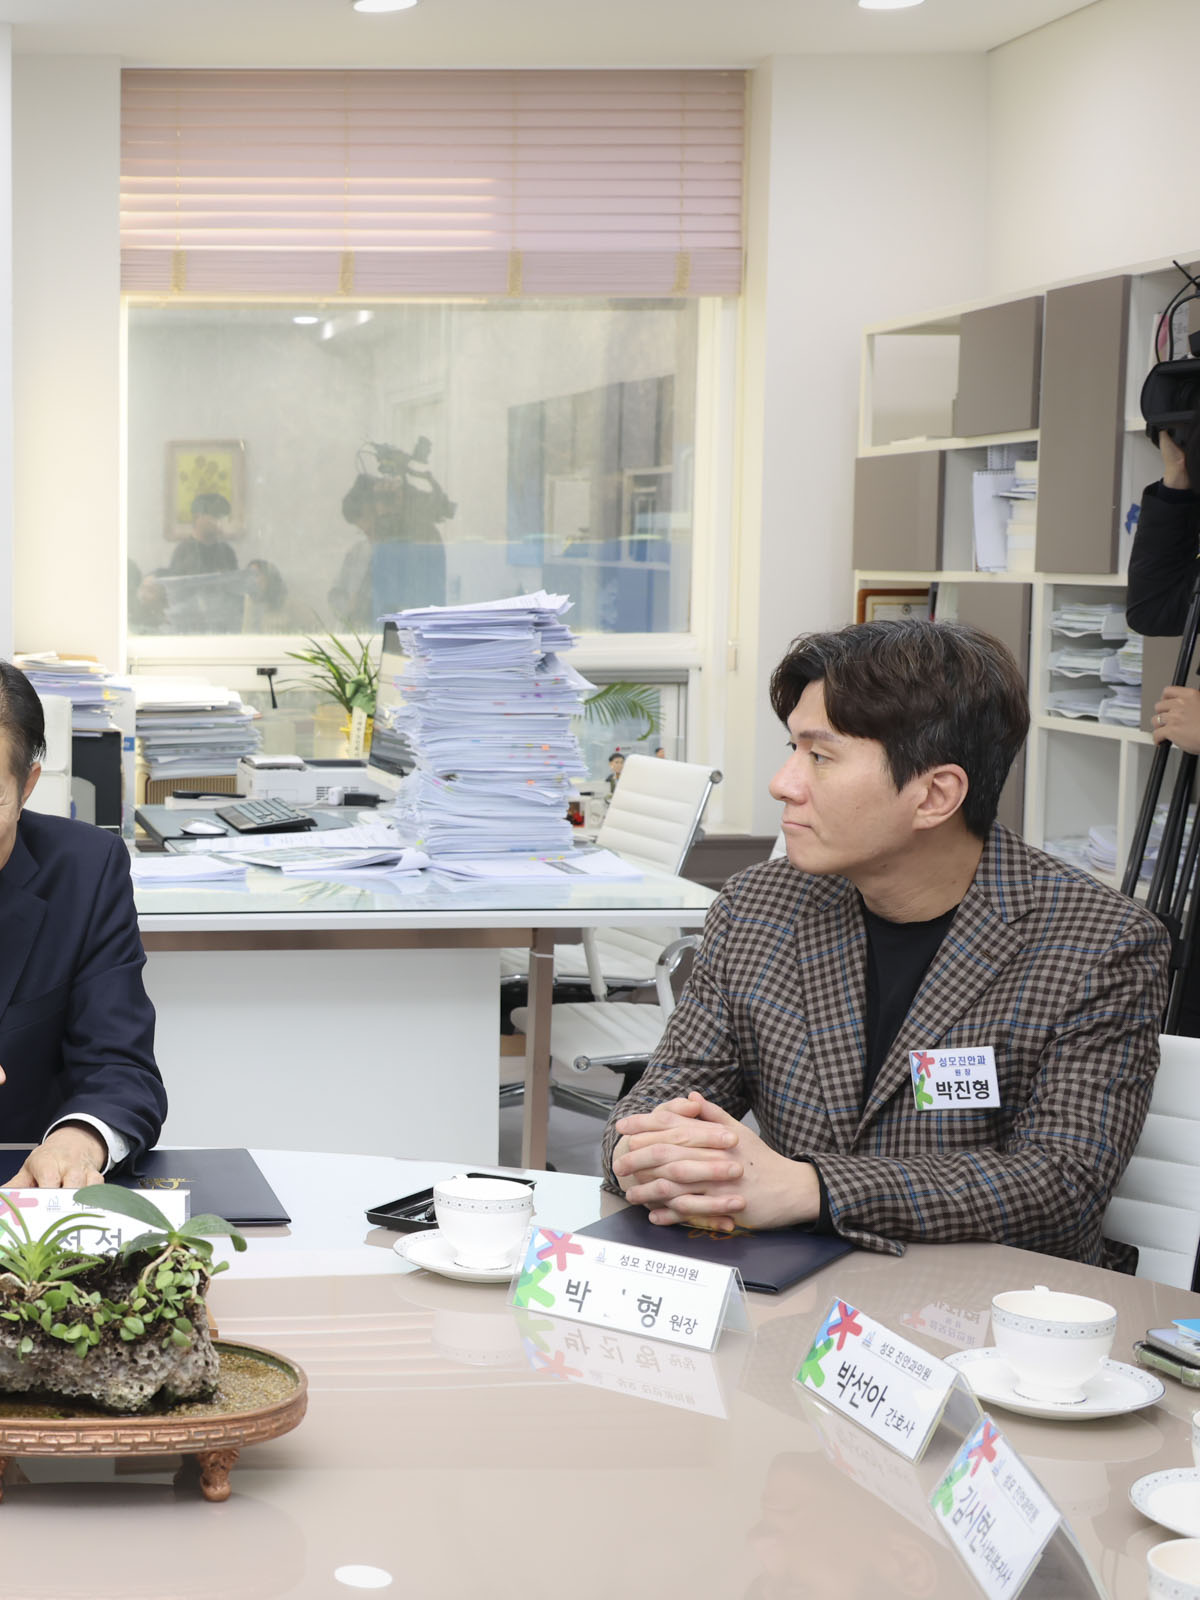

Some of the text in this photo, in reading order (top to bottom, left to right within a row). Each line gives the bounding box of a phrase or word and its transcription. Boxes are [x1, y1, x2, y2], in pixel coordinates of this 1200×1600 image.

[938, 1055, 987, 1068] 성모진안과
[935, 1079, 990, 1101] 박진형
[619, 1254, 700, 1282] 성모 진안과의원
[669, 1314, 699, 1335] 원장
[879, 1341, 933, 1382] 성모 진안과의원
[836, 1360, 916, 1439] 박선아 간호사
[952, 1485, 1015, 1590] 김시현 사회복지사
